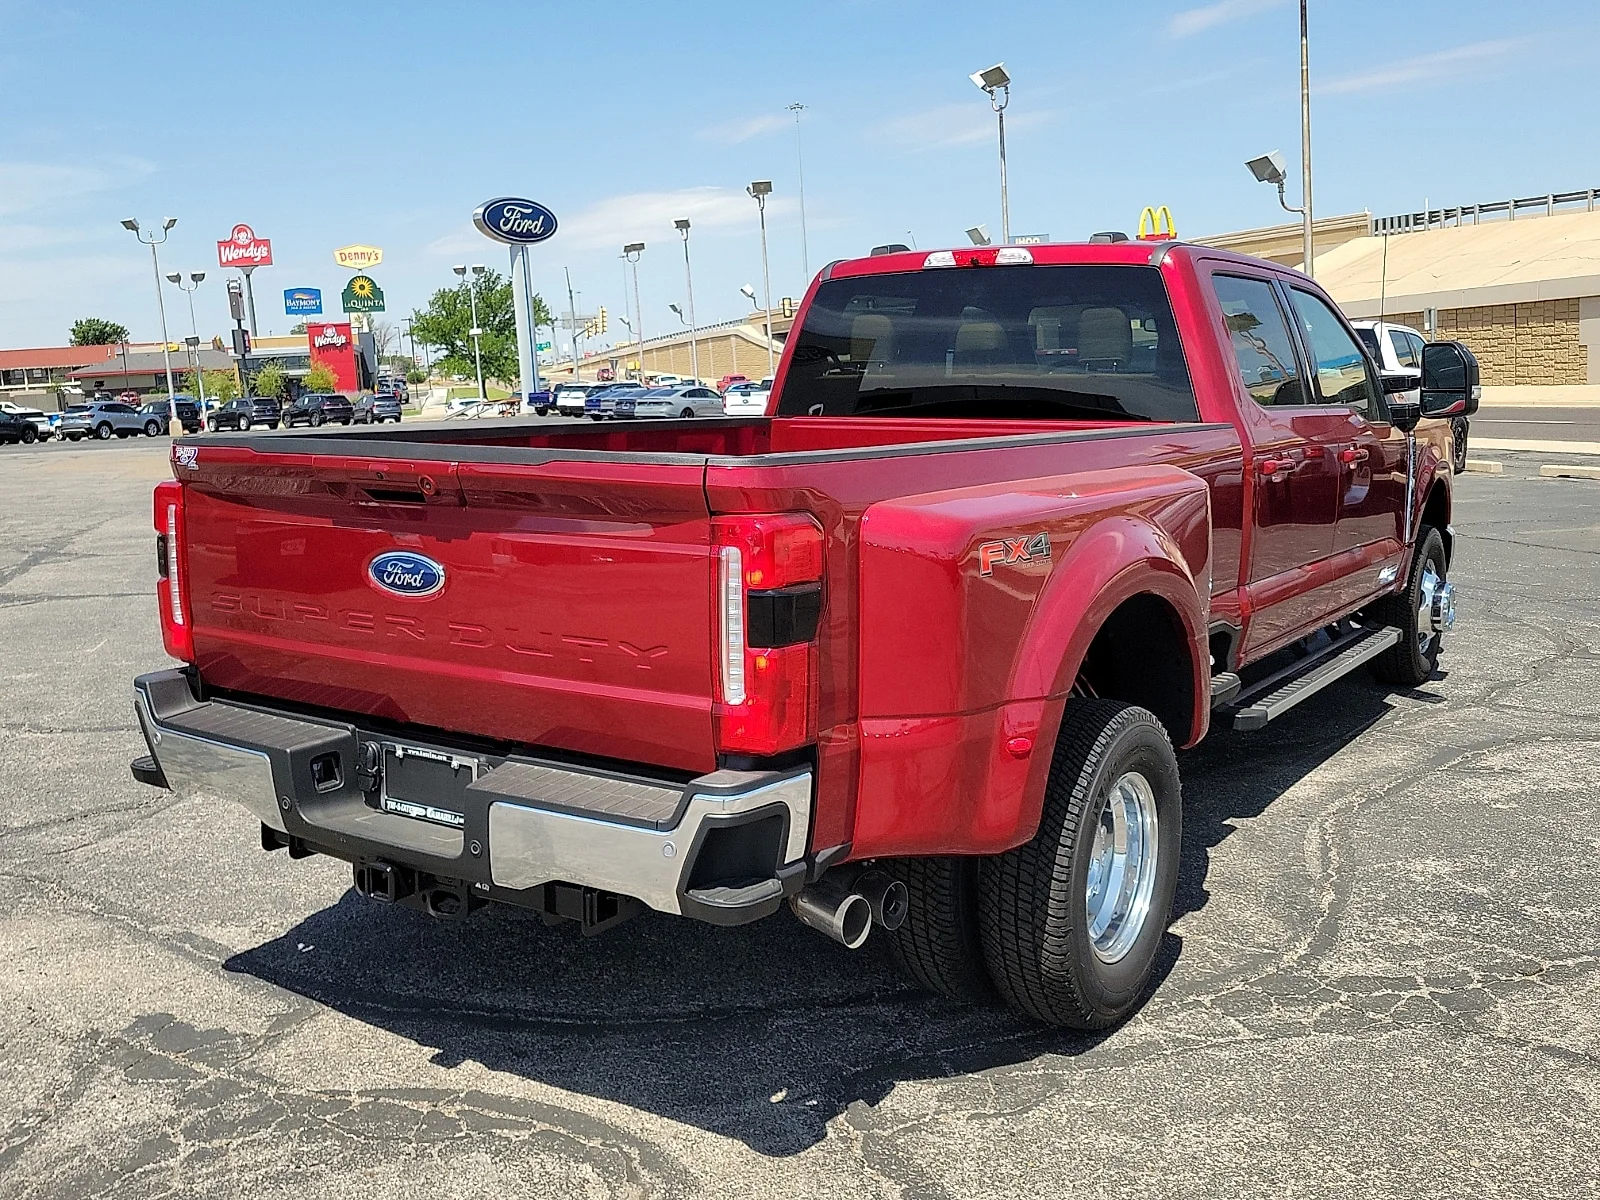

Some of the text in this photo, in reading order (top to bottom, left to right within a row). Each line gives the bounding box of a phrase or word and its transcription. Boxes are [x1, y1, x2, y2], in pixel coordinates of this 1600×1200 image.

[500, 205, 544, 234] Ford
[220, 241, 268, 263] Wendy's
[339, 250, 379, 262] Denny's
[286, 298, 320, 307] BAYMONT
[314, 333, 347, 348] Wendy's
[979, 531, 1051, 577] FX4
[383, 560, 424, 588] Ford
[211, 591, 669, 669] SUPER DUTY
